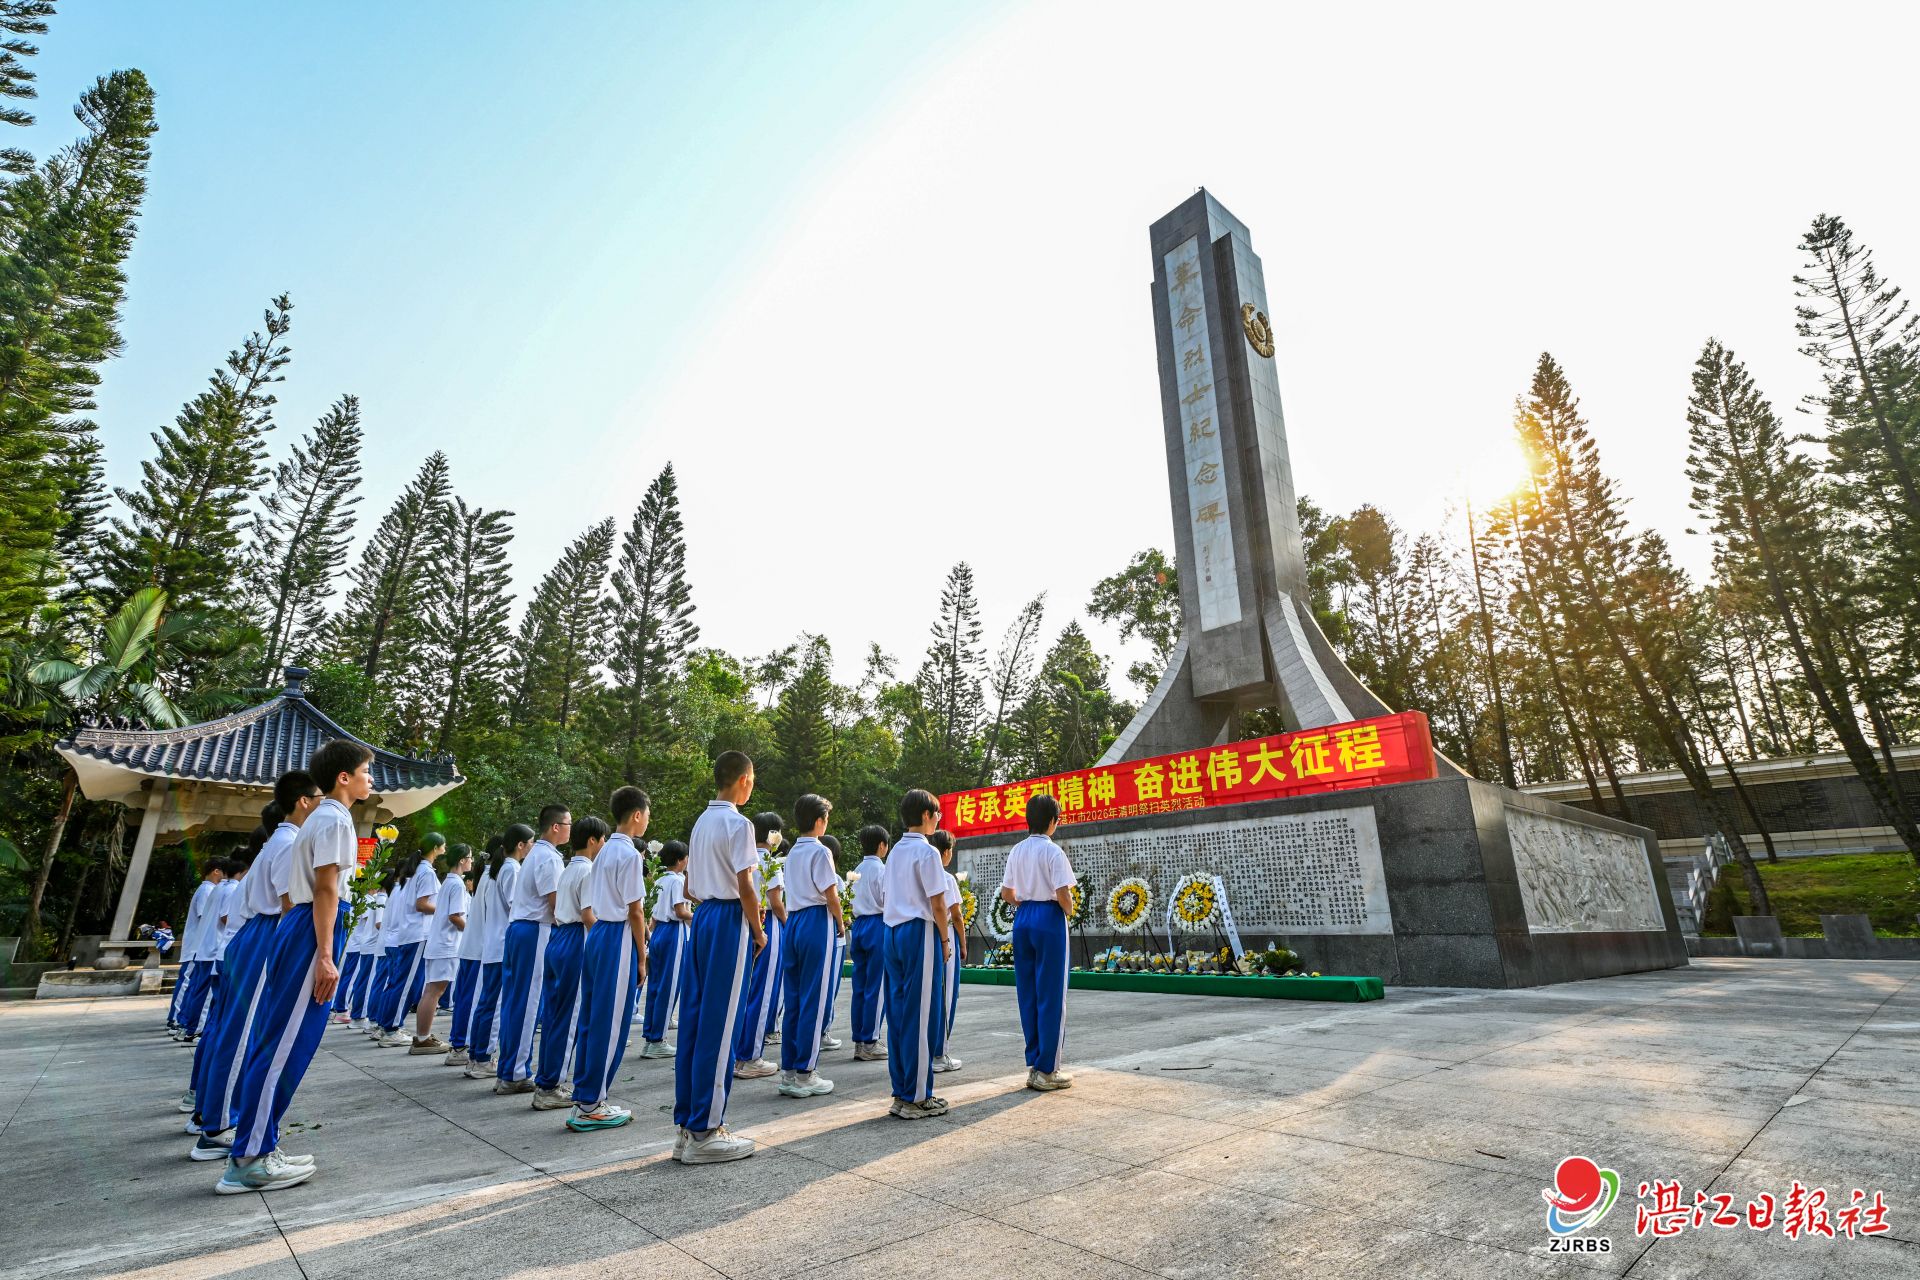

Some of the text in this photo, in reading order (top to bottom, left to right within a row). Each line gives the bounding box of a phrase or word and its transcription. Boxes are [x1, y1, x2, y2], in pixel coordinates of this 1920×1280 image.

[1133, 725, 1385, 801] 奋进伟大征程
[1059, 796, 1206, 825] 湛江市2026年清明祭扫英烈活动
